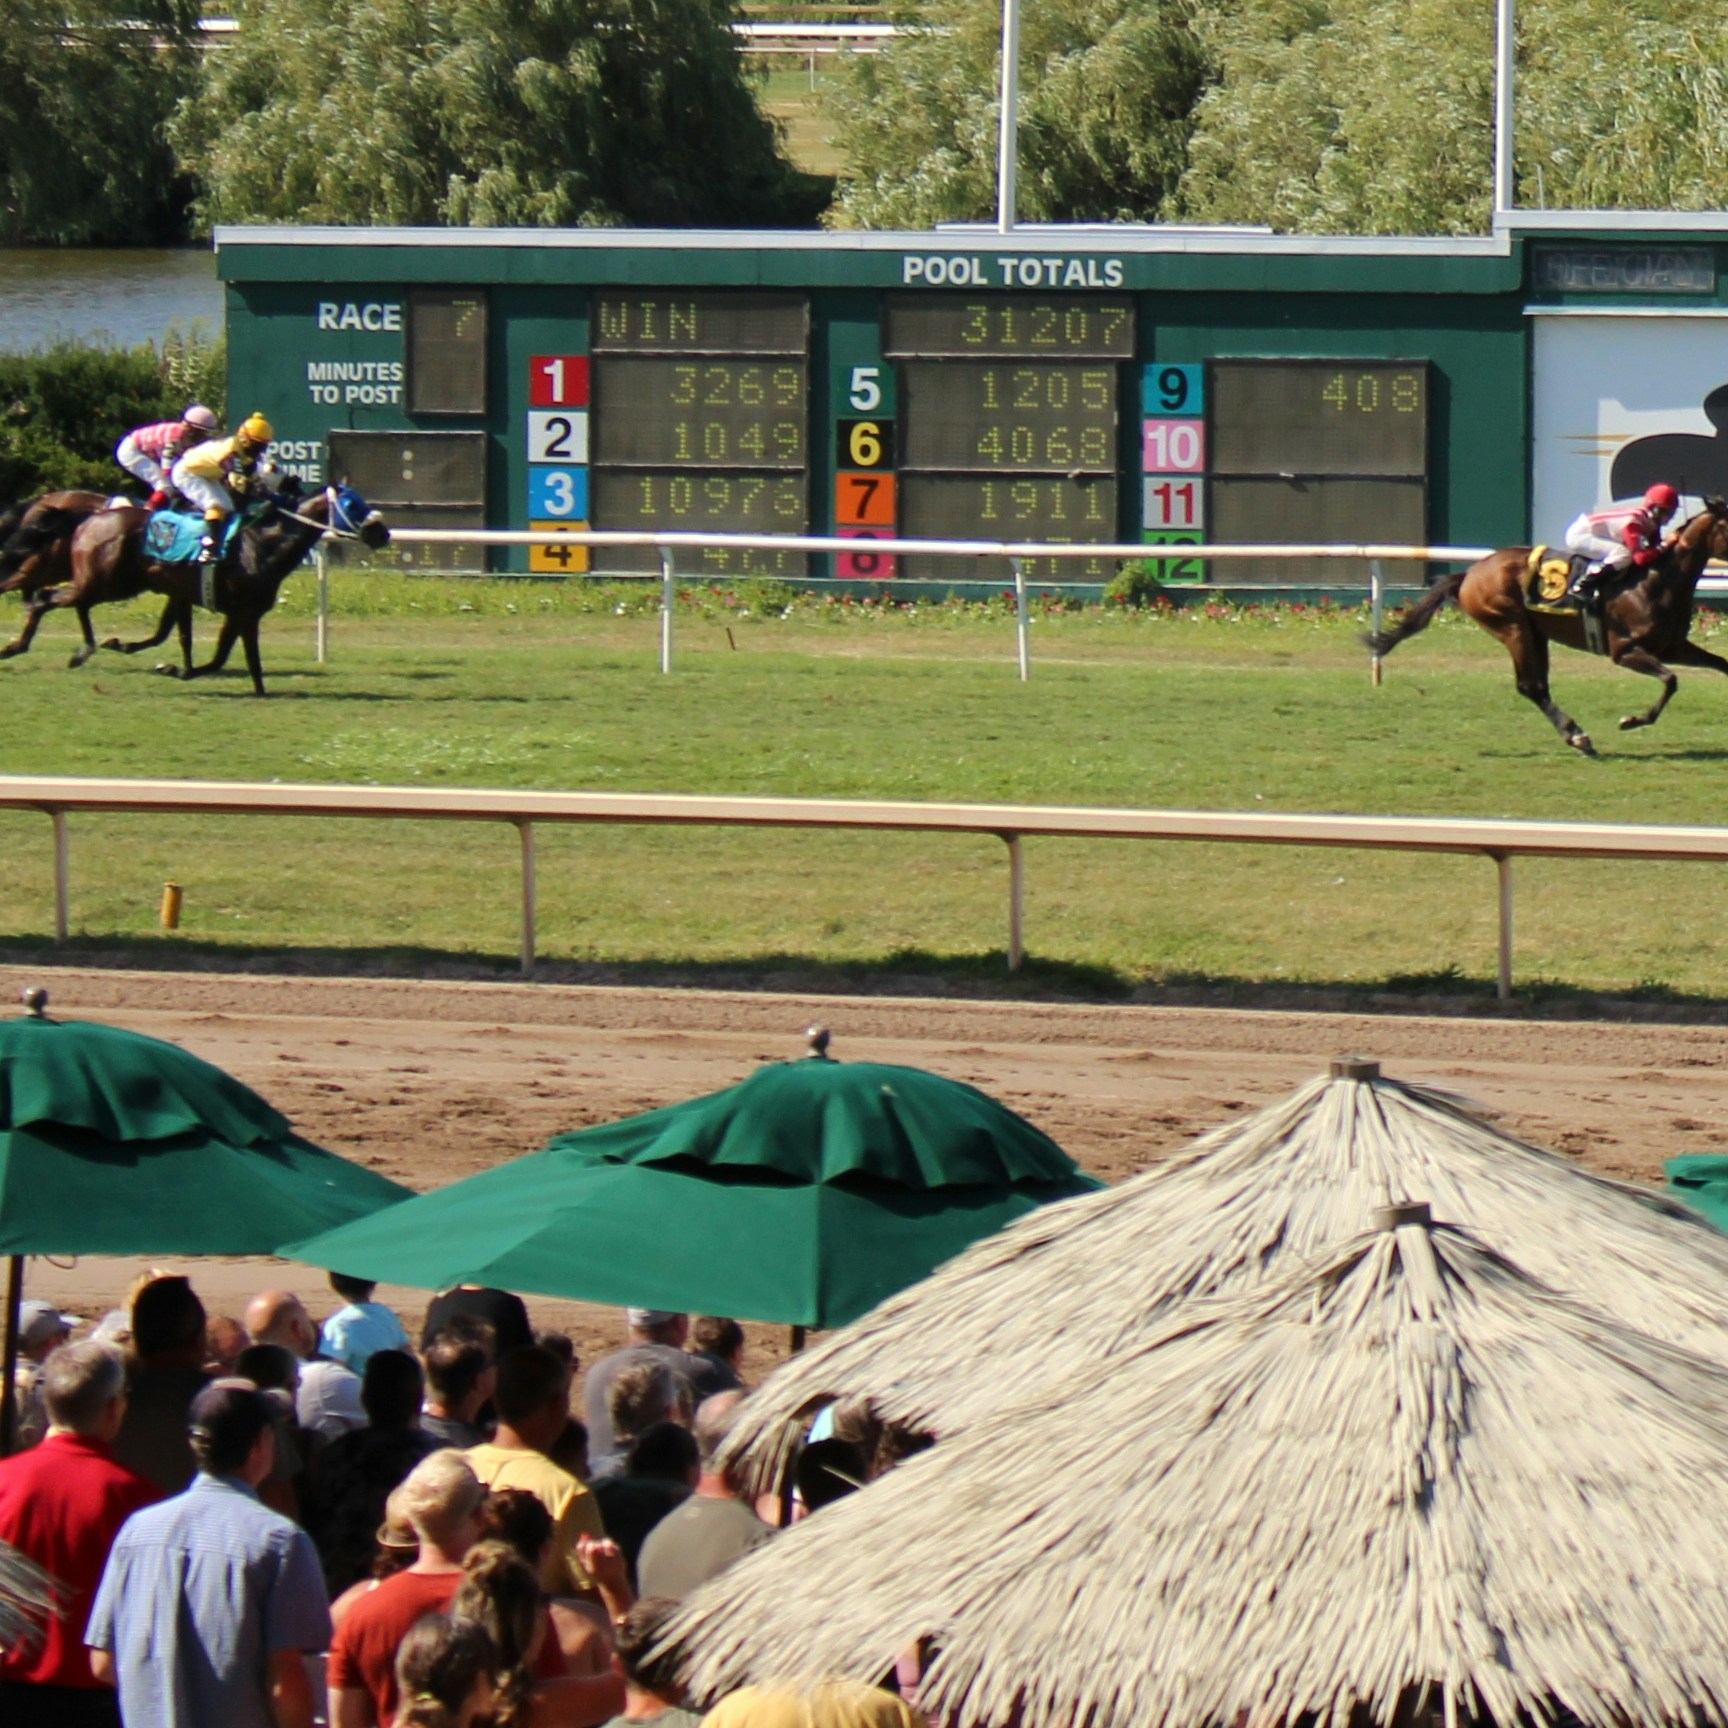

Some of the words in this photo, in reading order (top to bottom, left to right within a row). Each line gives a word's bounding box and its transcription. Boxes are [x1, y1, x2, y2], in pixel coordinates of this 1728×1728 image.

[903, 256, 987, 285] POOL
[997, 258, 1124, 288] TOTALS
[318, 302, 402, 332] RACE
[452, 300, 478, 338] 7
[601, 301, 697, 339] WIN
[962, 305, 1127, 345] 31207
[307, 361, 403, 383] MINUTES
[543, 359, 564, 402] 1
[671, 367, 801, 404] 3269
[849, 368, 881, 411] 5
[981, 371, 1110, 409] 1205
[1158, 368, 1188, 410] 9
[309, 384, 340, 405] TO
[345, 384, 402, 405] POST
[1322, 375, 1419, 412] 408
[266, 440, 322, 461] POST
[544, 417, 573, 458] 2
[673, 422, 801, 459] 1049
[849, 422, 881, 465] 6
[978, 427, 1107, 465] 4068
[1147, 424, 1199, 468] 10
[543, 474, 575, 516] 3
[639, 477, 801, 515] 10976
[849, 479, 879, 519] 7
[980, 482, 1103, 520] 1911
[1152, 482, 1195, 525] 11
[541, 526, 573, 568] 4
[1154, 534, 1198, 581] 12
[1539, 559, 1569, 600] 6
